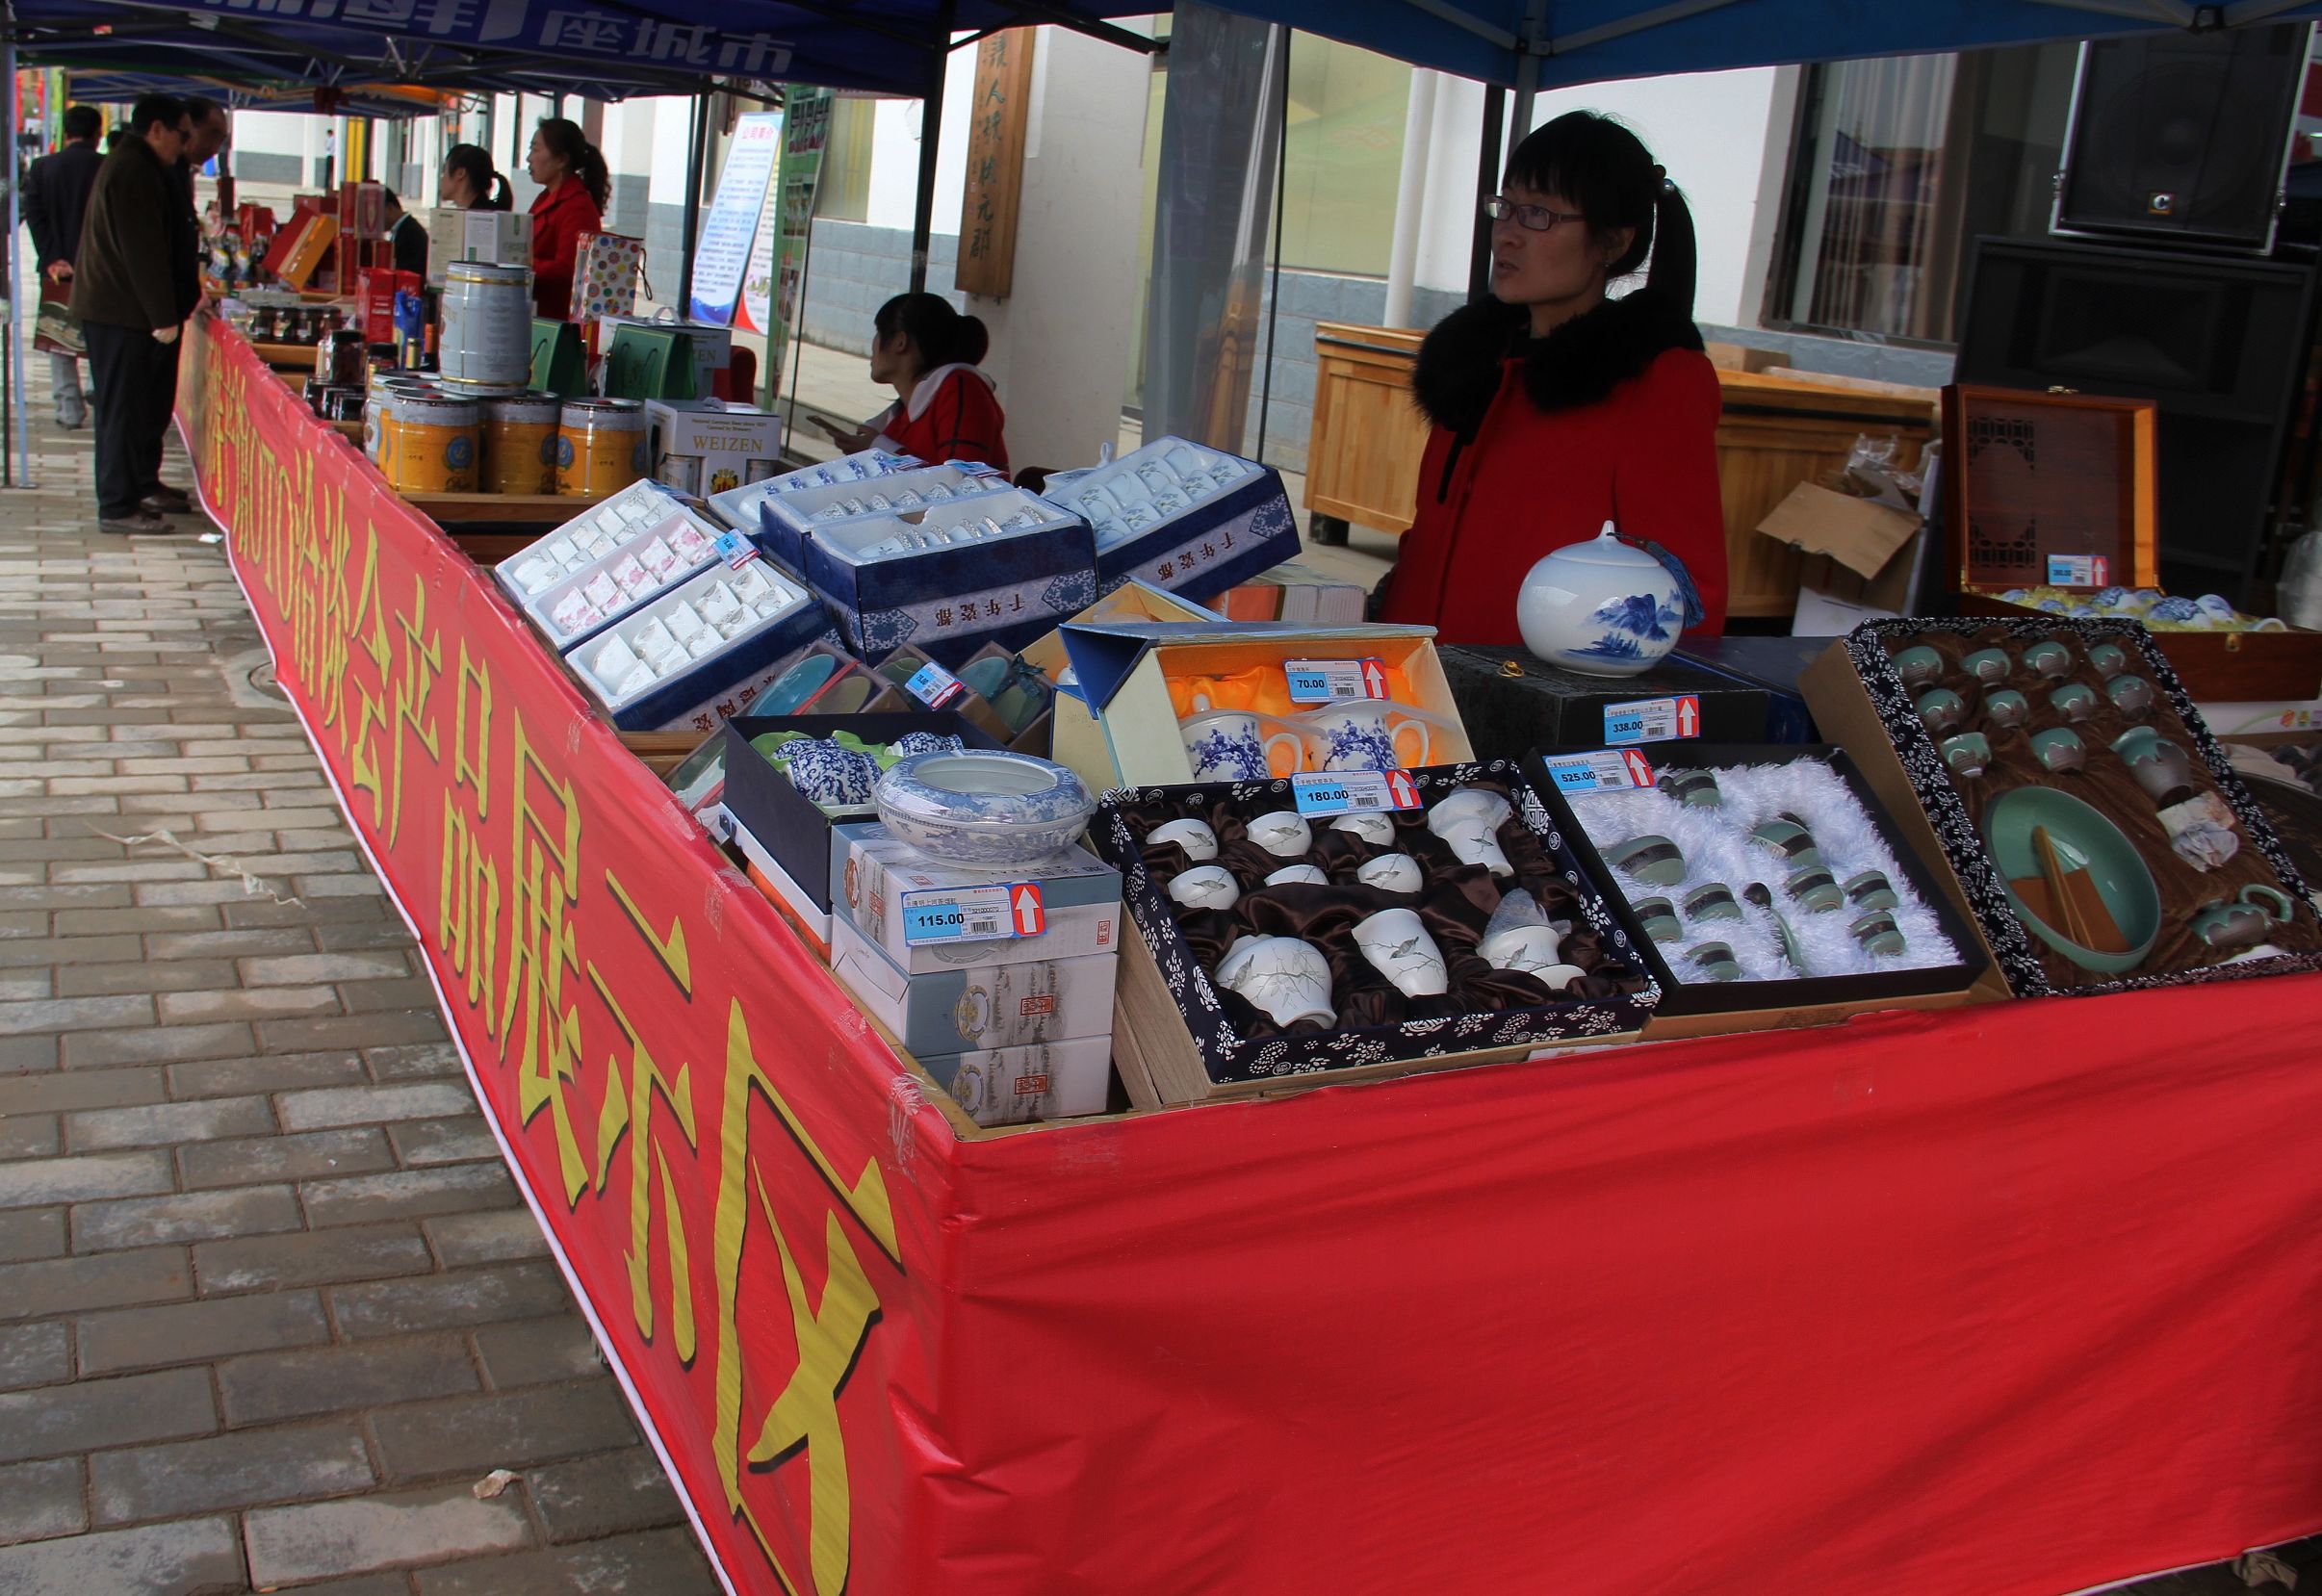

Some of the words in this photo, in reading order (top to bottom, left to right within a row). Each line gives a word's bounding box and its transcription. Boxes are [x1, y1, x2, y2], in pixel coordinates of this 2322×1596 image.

[693, 435, 762, 453] WEIZEN
[1157, 532, 1236, 581] 千年瓷都
[936, 594, 1025, 627] 千年瓷都
[1297, 680, 1325, 688] 70.00
[1612, 720, 1643, 733] 338.00
[1561, 771, 1596, 783] 525.00
[1307, 790, 1349, 802] 180.00
[917, 913, 965, 927] 115.00
